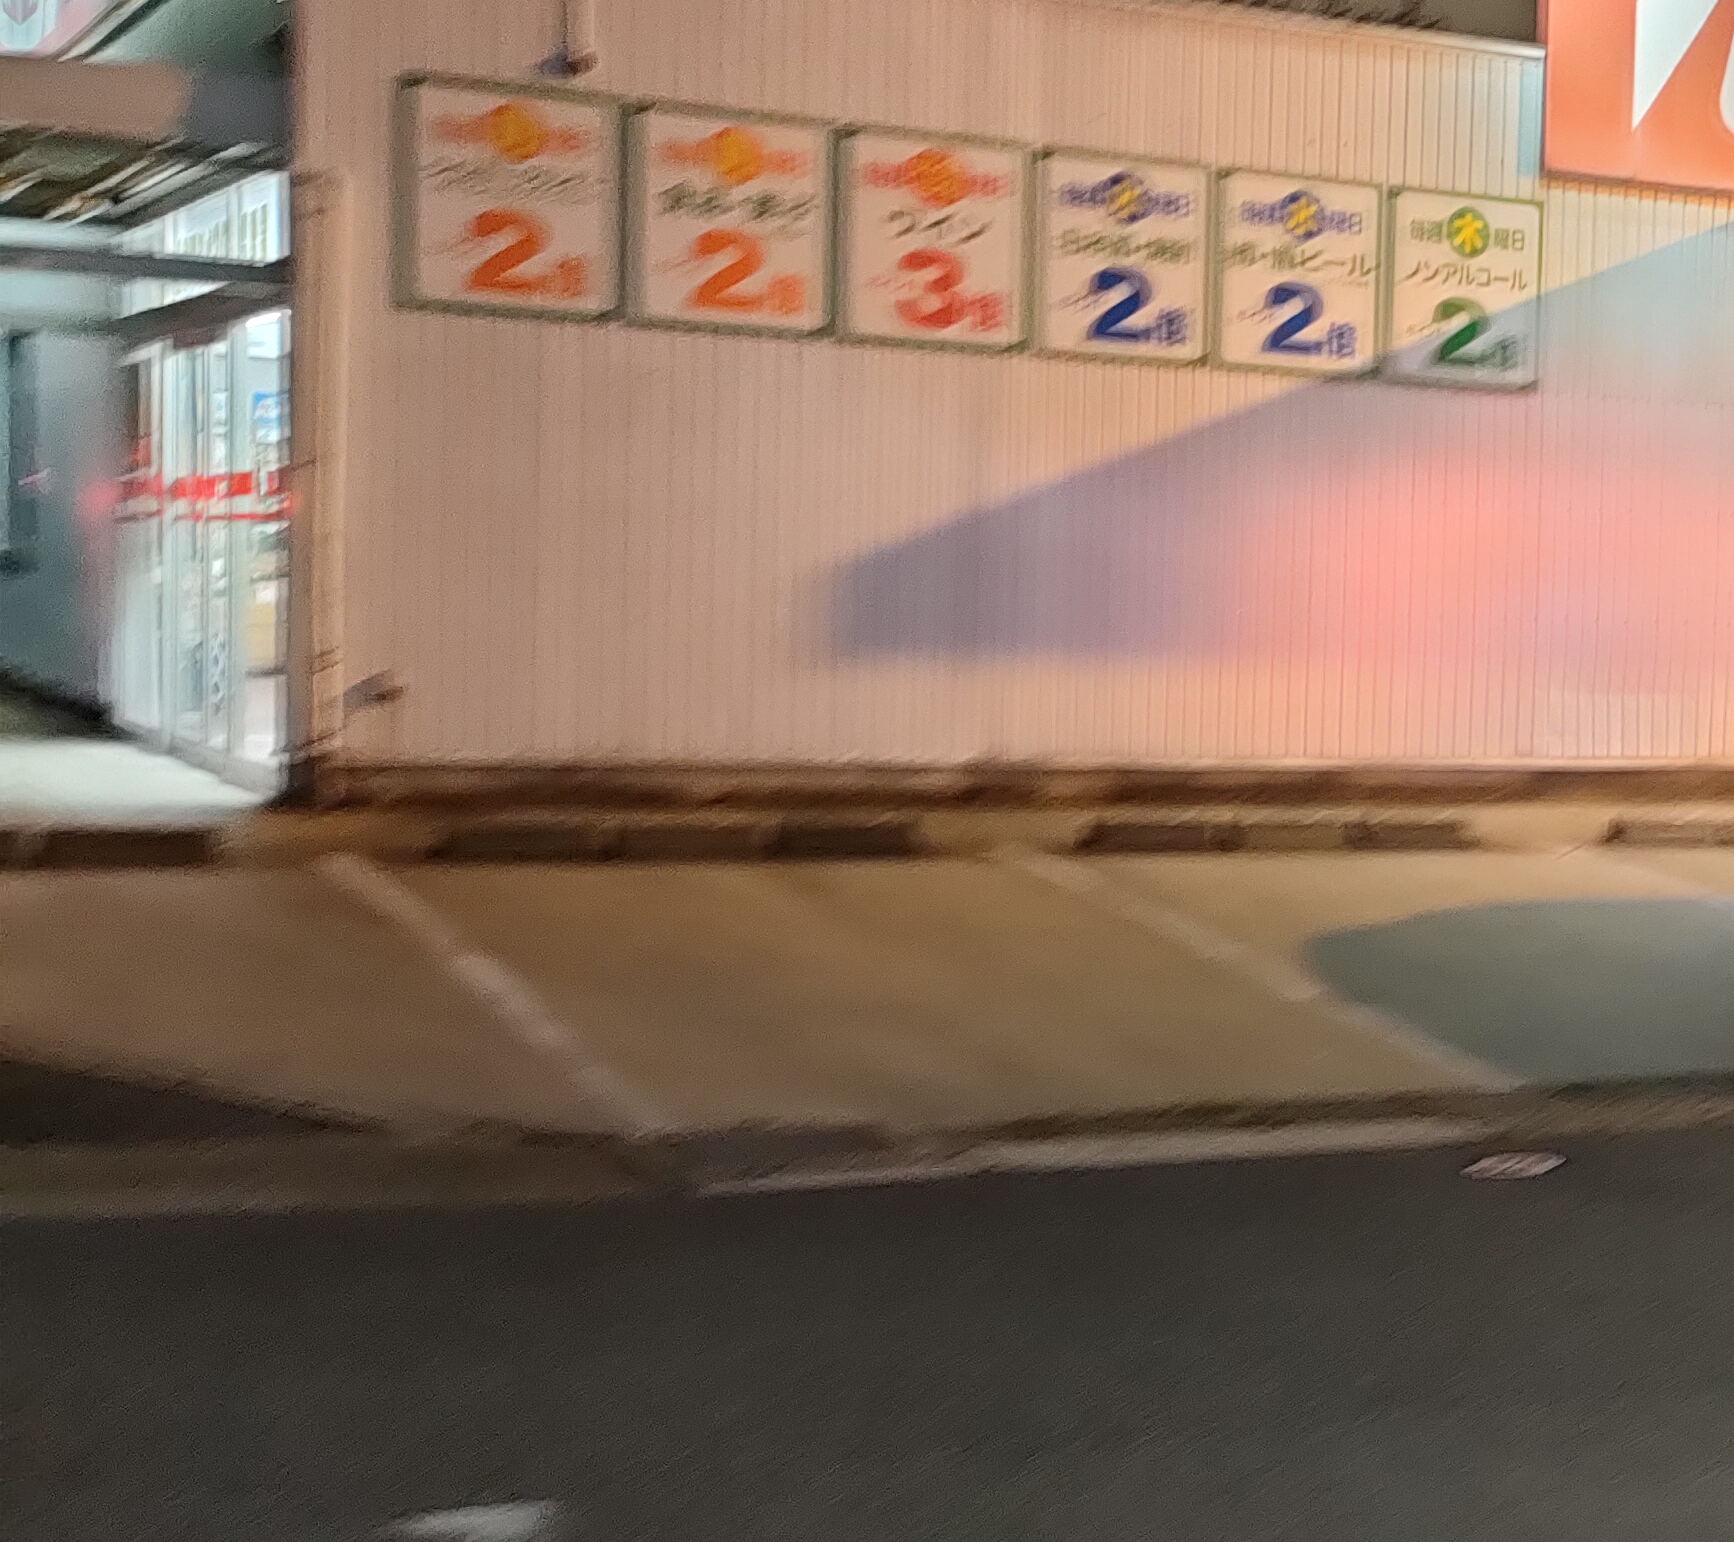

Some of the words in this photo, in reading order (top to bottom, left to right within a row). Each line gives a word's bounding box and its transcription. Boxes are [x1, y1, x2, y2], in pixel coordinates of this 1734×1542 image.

[1404, 260, 1528, 292] ノンアルコール
